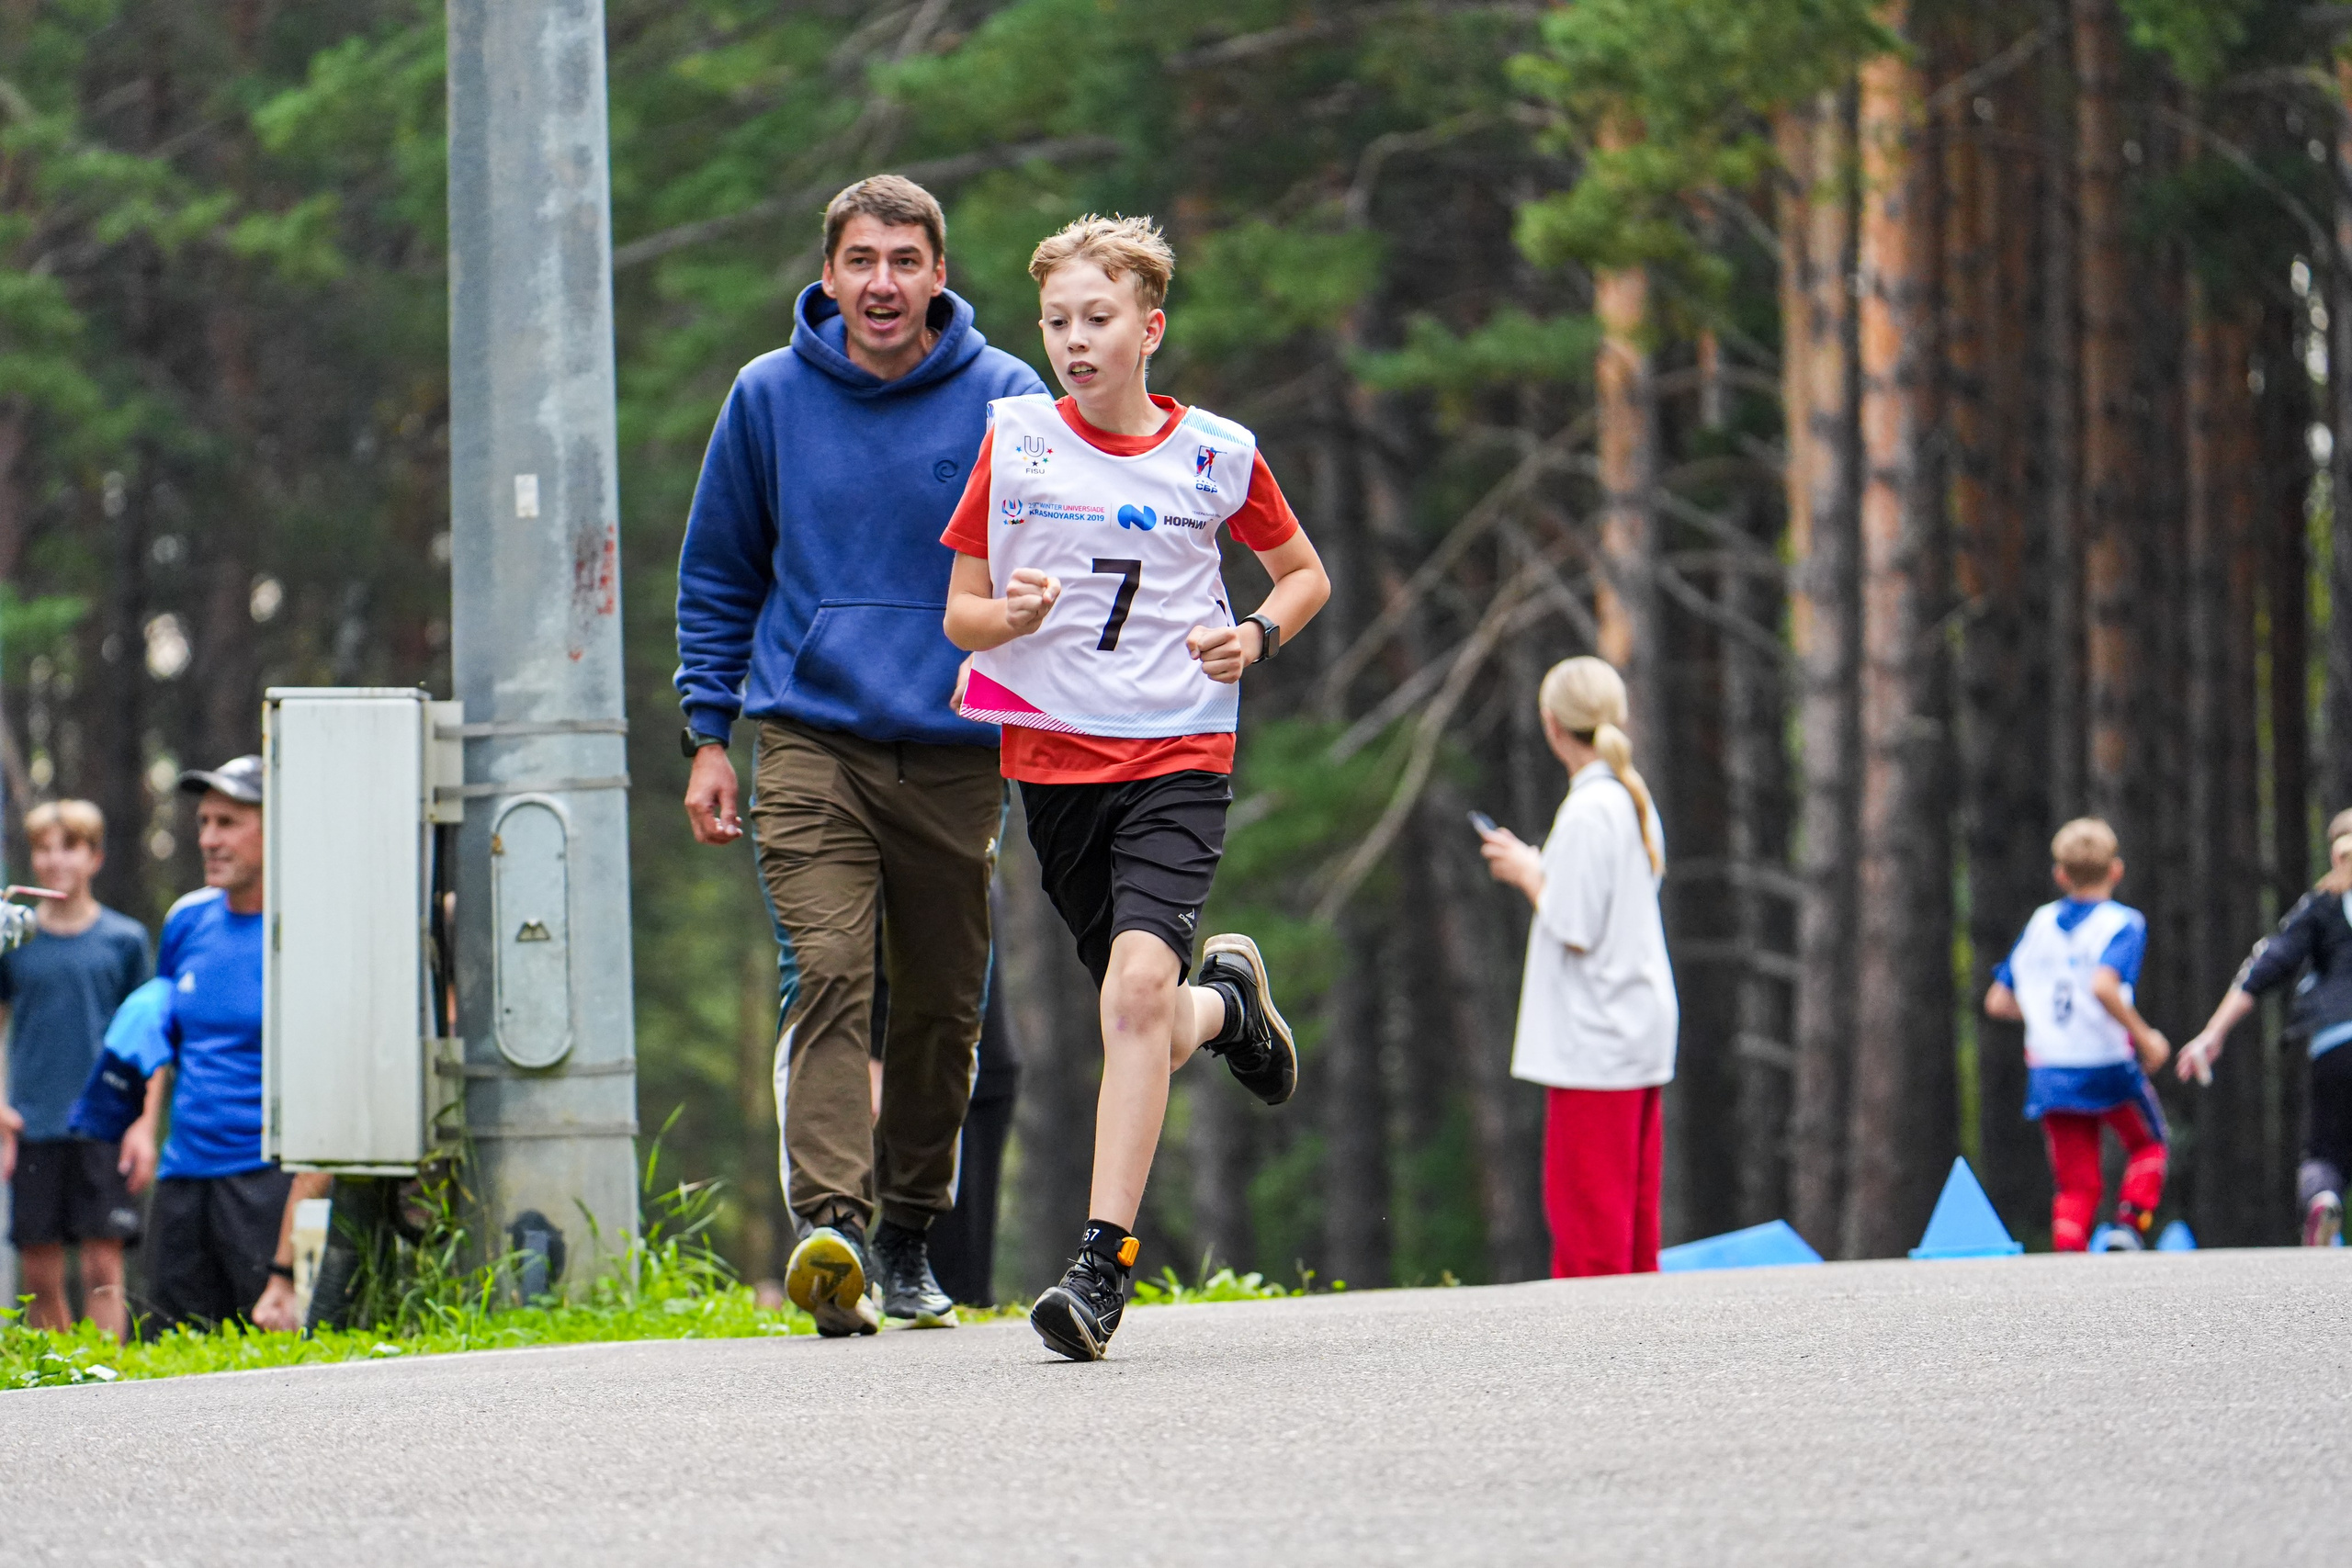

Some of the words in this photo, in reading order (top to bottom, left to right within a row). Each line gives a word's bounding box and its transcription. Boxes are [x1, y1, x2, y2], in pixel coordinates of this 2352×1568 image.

[1195, 483, 1218, 493] СБР
[1039, 502, 1063, 511] WINTER
[1063, 504, 1105, 513] UNIVERSIADE
[1029, 509, 1085, 521] KRASNOYARSK
[1086, 513, 1105, 522] 2019
[1091, 558, 1142, 652] 7
